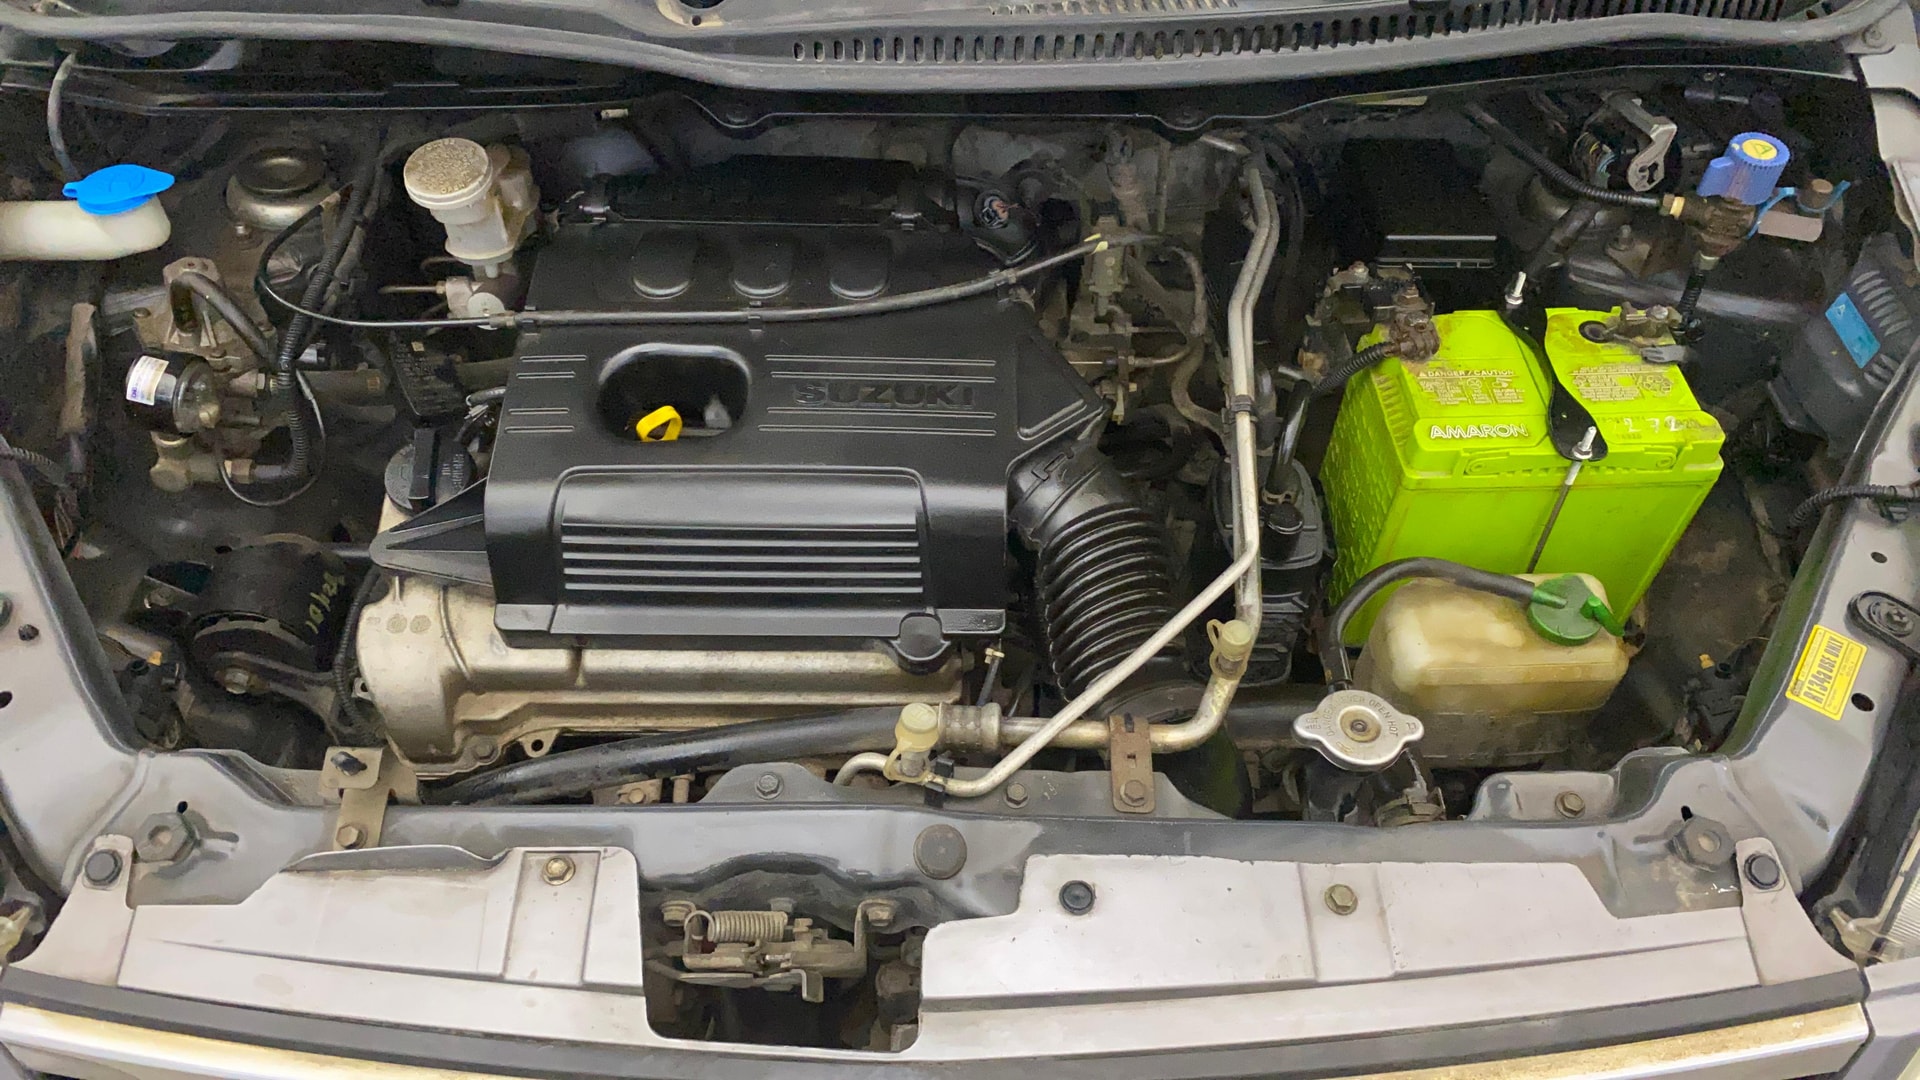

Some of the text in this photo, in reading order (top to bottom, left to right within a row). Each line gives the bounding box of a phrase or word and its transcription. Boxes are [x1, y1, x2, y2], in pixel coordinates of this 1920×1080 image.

[794, 382, 974, 410] SUZUKI
[1430, 423, 1529, 439] AMARON
[1824, 635, 1844, 658] ONLY
[1817, 655, 1837, 674] USE
[1803, 670, 1833, 704] R134a
[1368, 699, 1393, 719] OPEN
[1387, 720, 1399, 737] HOT
